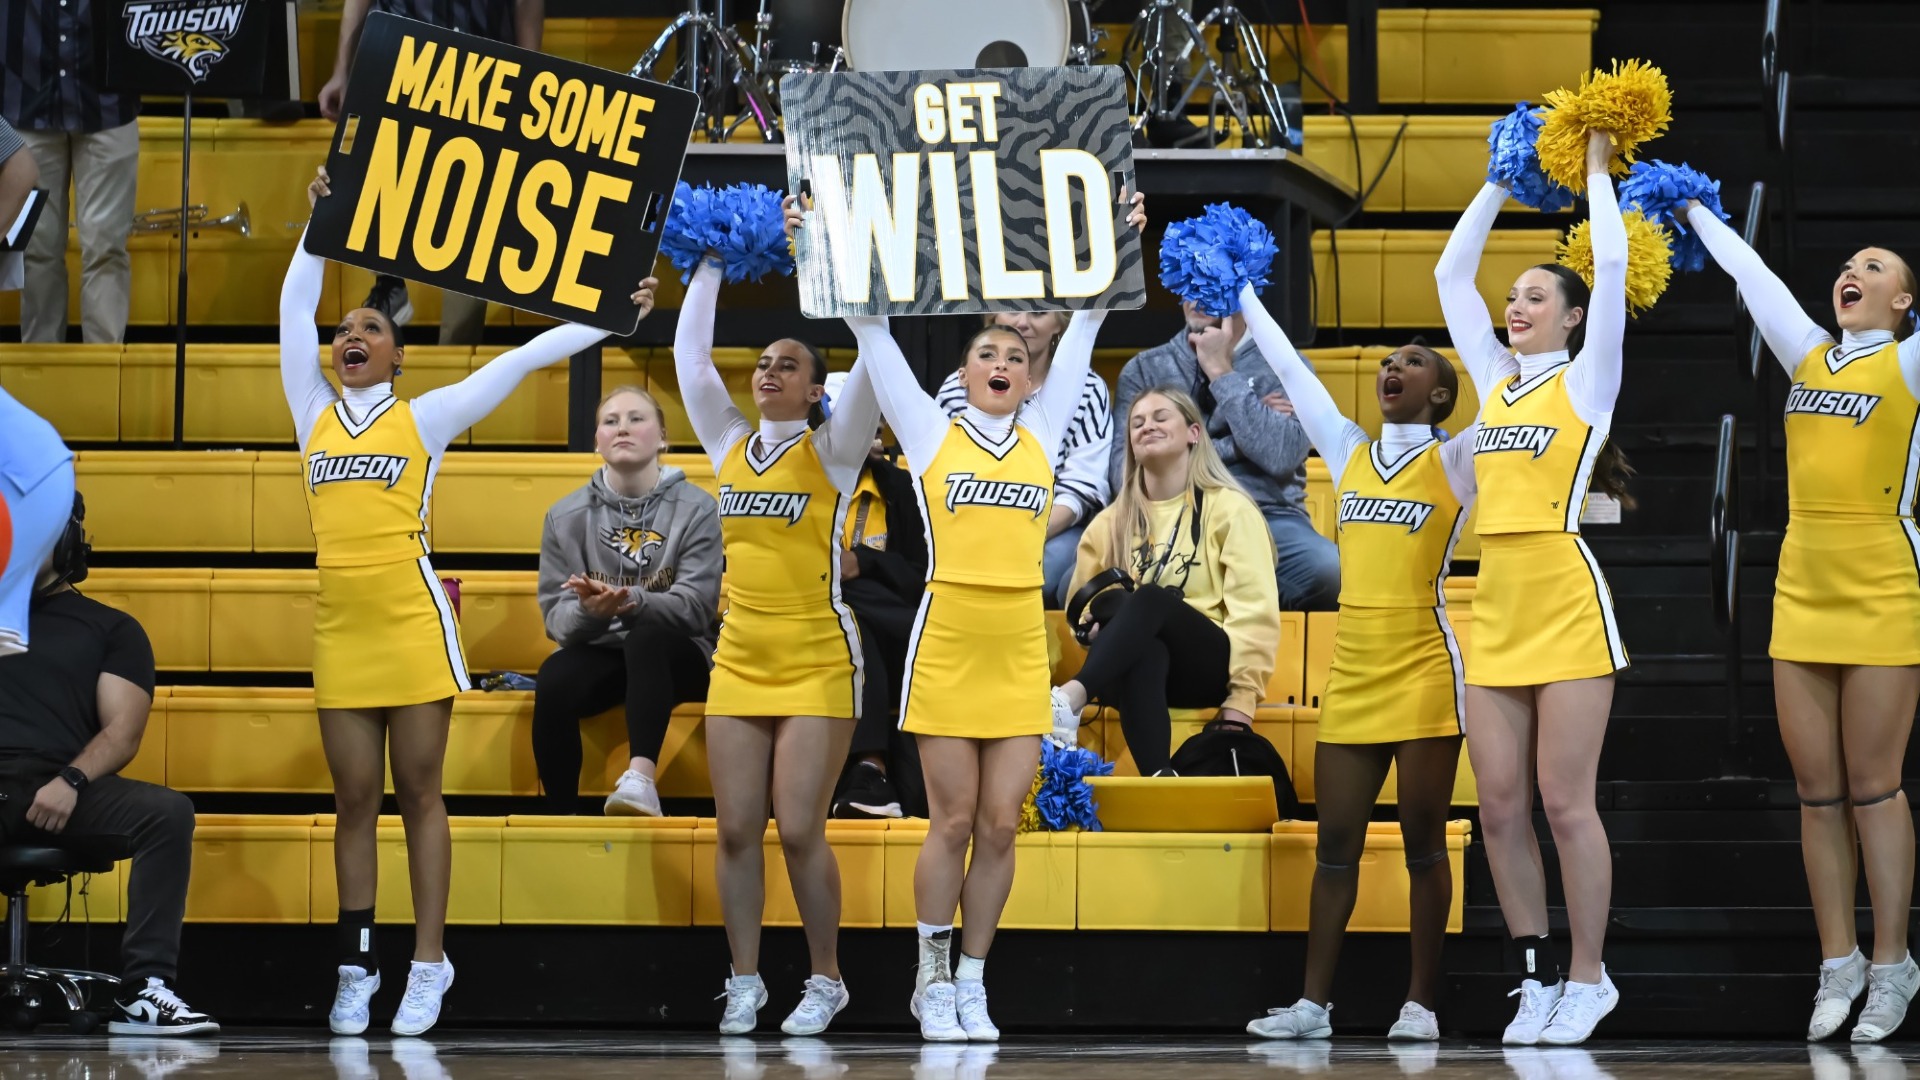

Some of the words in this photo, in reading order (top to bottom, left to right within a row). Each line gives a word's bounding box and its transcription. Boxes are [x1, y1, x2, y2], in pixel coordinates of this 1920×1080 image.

[127, 4, 241, 44] TOWSON
[386, 35, 521, 131] MAKE
[520, 71, 656, 166] SOME
[914, 81, 1001, 144] GET
[345, 116, 633, 313] NOISE
[810, 148, 1118, 303] WILD
[1473, 422, 1558, 459] OWSON
[308, 451, 409, 496] TOWSON
[945, 472, 1049, 518] TOWSON
[718, 484, 812, 527] TOWSON
[1338, 491, 1436, 534] TOWSON
